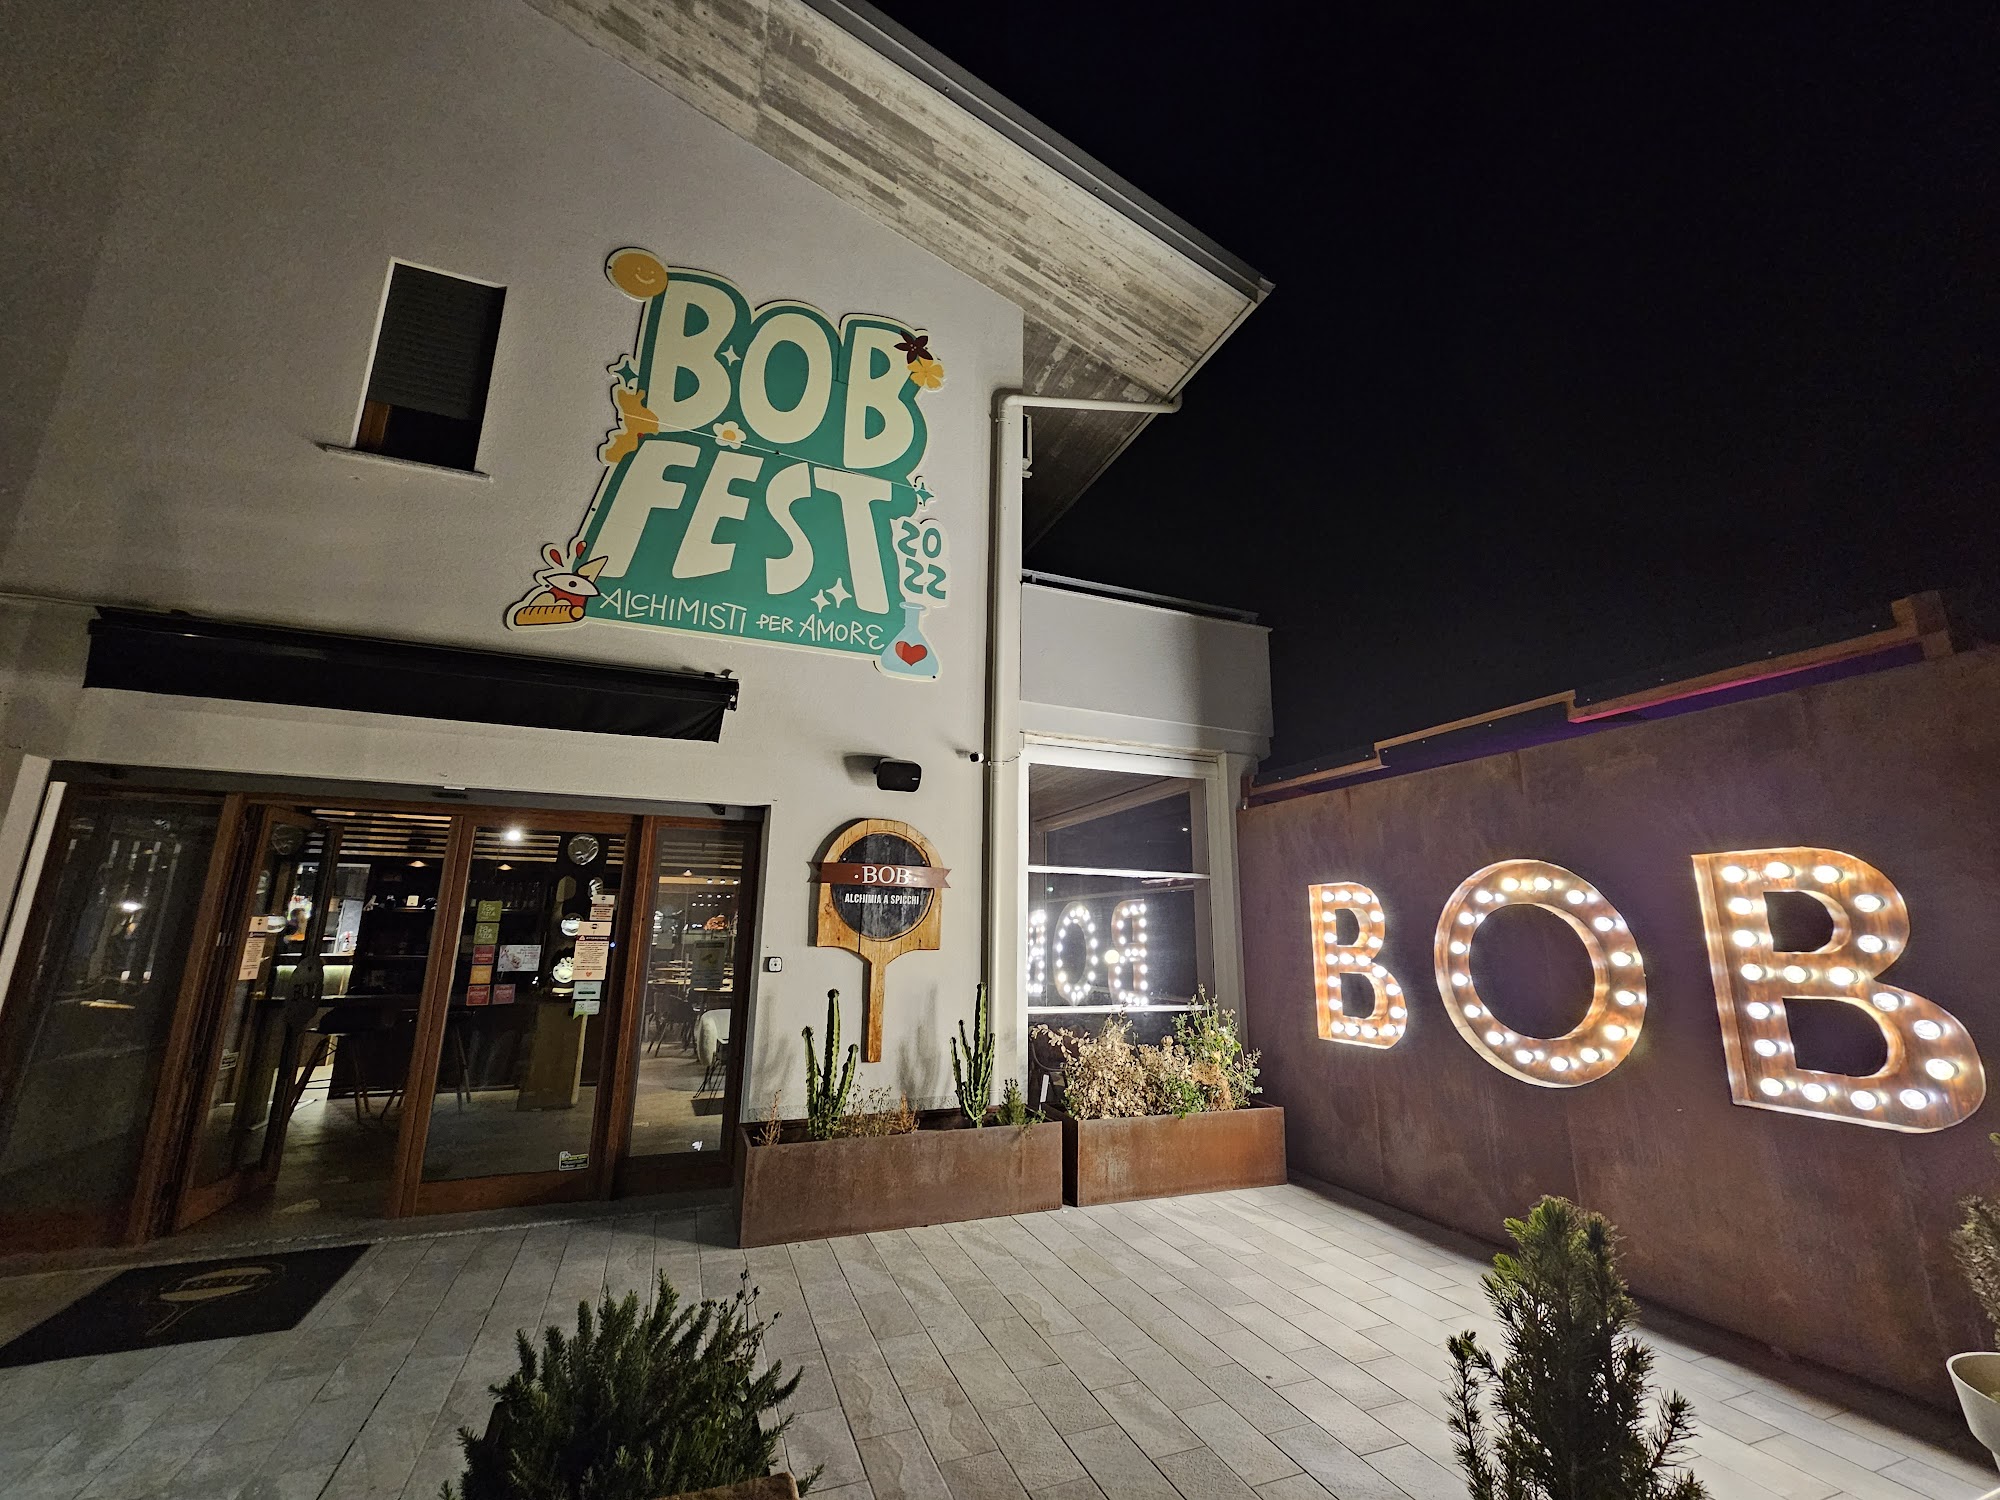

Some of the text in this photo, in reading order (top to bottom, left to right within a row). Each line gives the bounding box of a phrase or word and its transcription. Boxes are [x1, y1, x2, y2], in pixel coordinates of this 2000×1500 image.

[647, 280, 914, 468] BOB
[589, 440, 892, 614] FEST
[898, 521, 942, 559] 20
[903, 559, 947, 600] 22
[600, 588, 885, 650] ALCHIMISTI PER AMORE
[844, 893, 919, 905] ALCHIMIA A SPICCHI
[861, 866, 909, 885] BOB
[1309, 846, 1986, 1133] BOB
